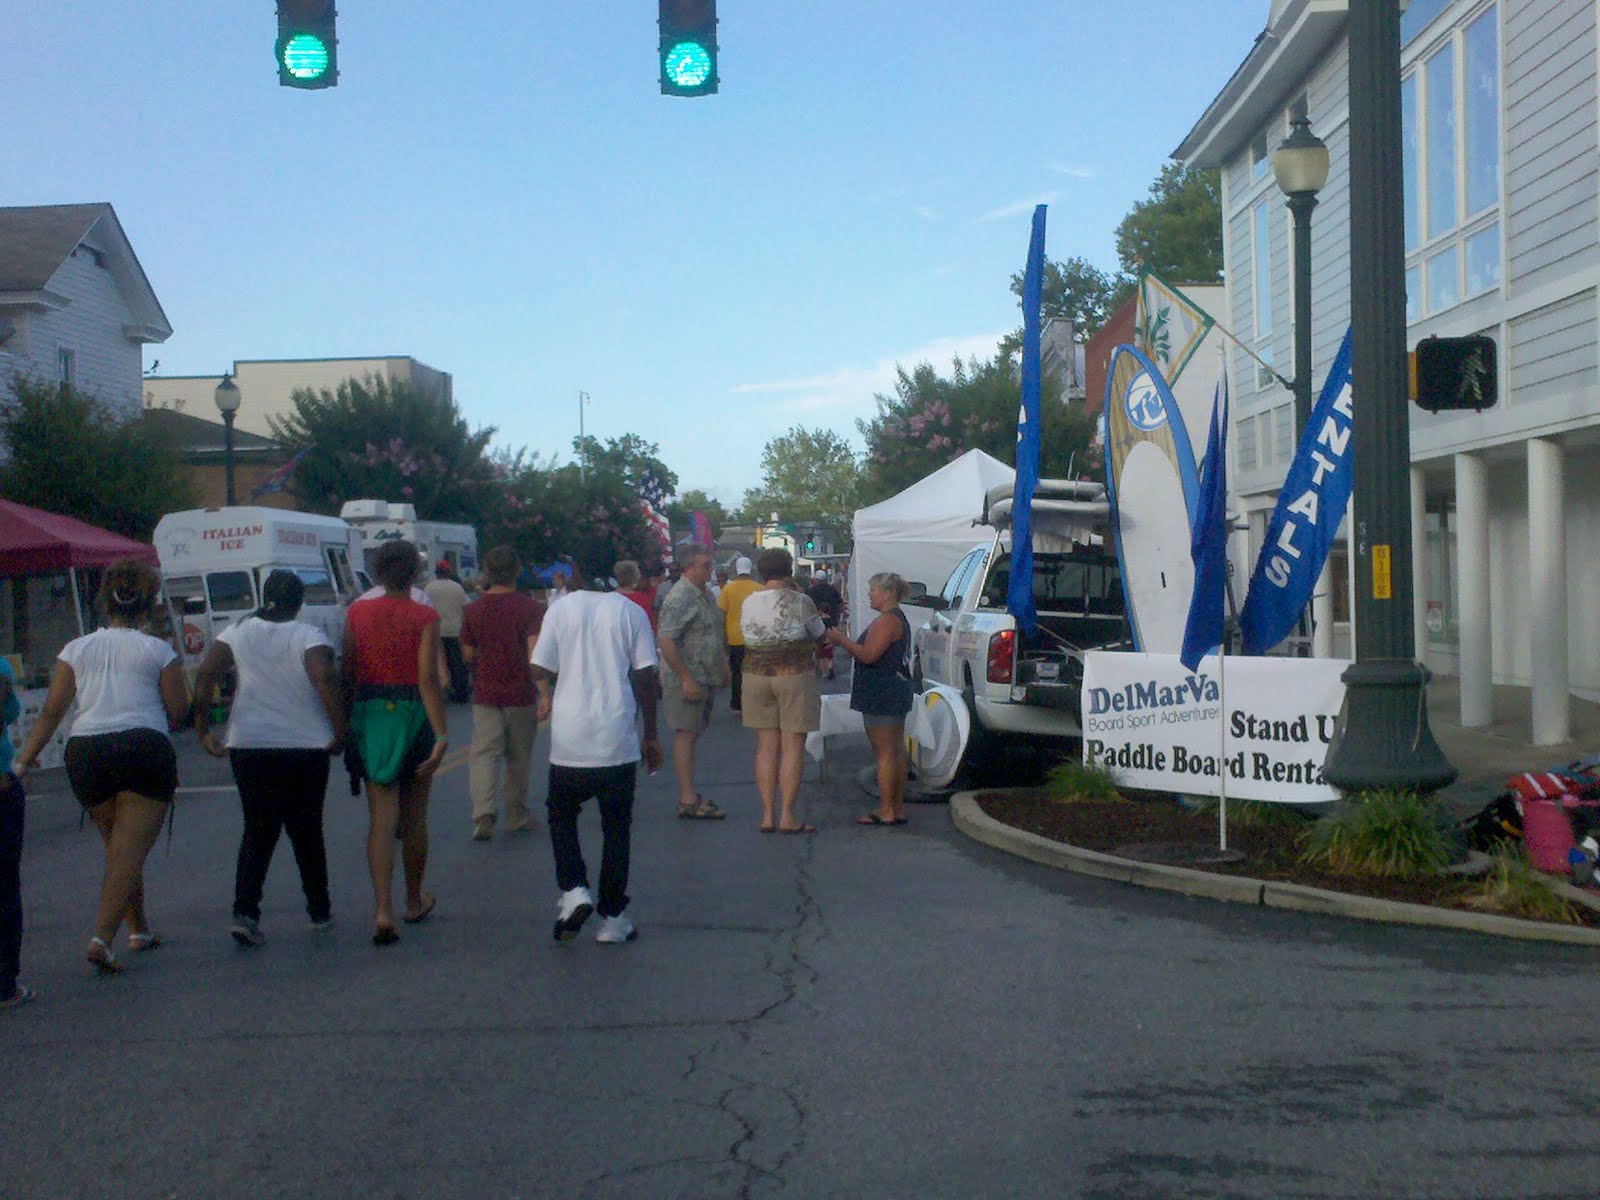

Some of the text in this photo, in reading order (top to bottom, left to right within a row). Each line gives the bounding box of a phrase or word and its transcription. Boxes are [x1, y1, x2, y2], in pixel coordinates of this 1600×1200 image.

[1264, 366, 1353, 588] ENTALS
[203, 525, 262, 539] ITALIAN
[220, 539, 244, 550] ICE
[1088, 674, 1219, 714] DelMarVa
[1088, 717, 1124, 732] Board
[1127, 711, 1156, 730] Sport
[1231, 710, 1337, 743] Stand U
[1086, 739, 1328, 785] Paddle Board Renta
